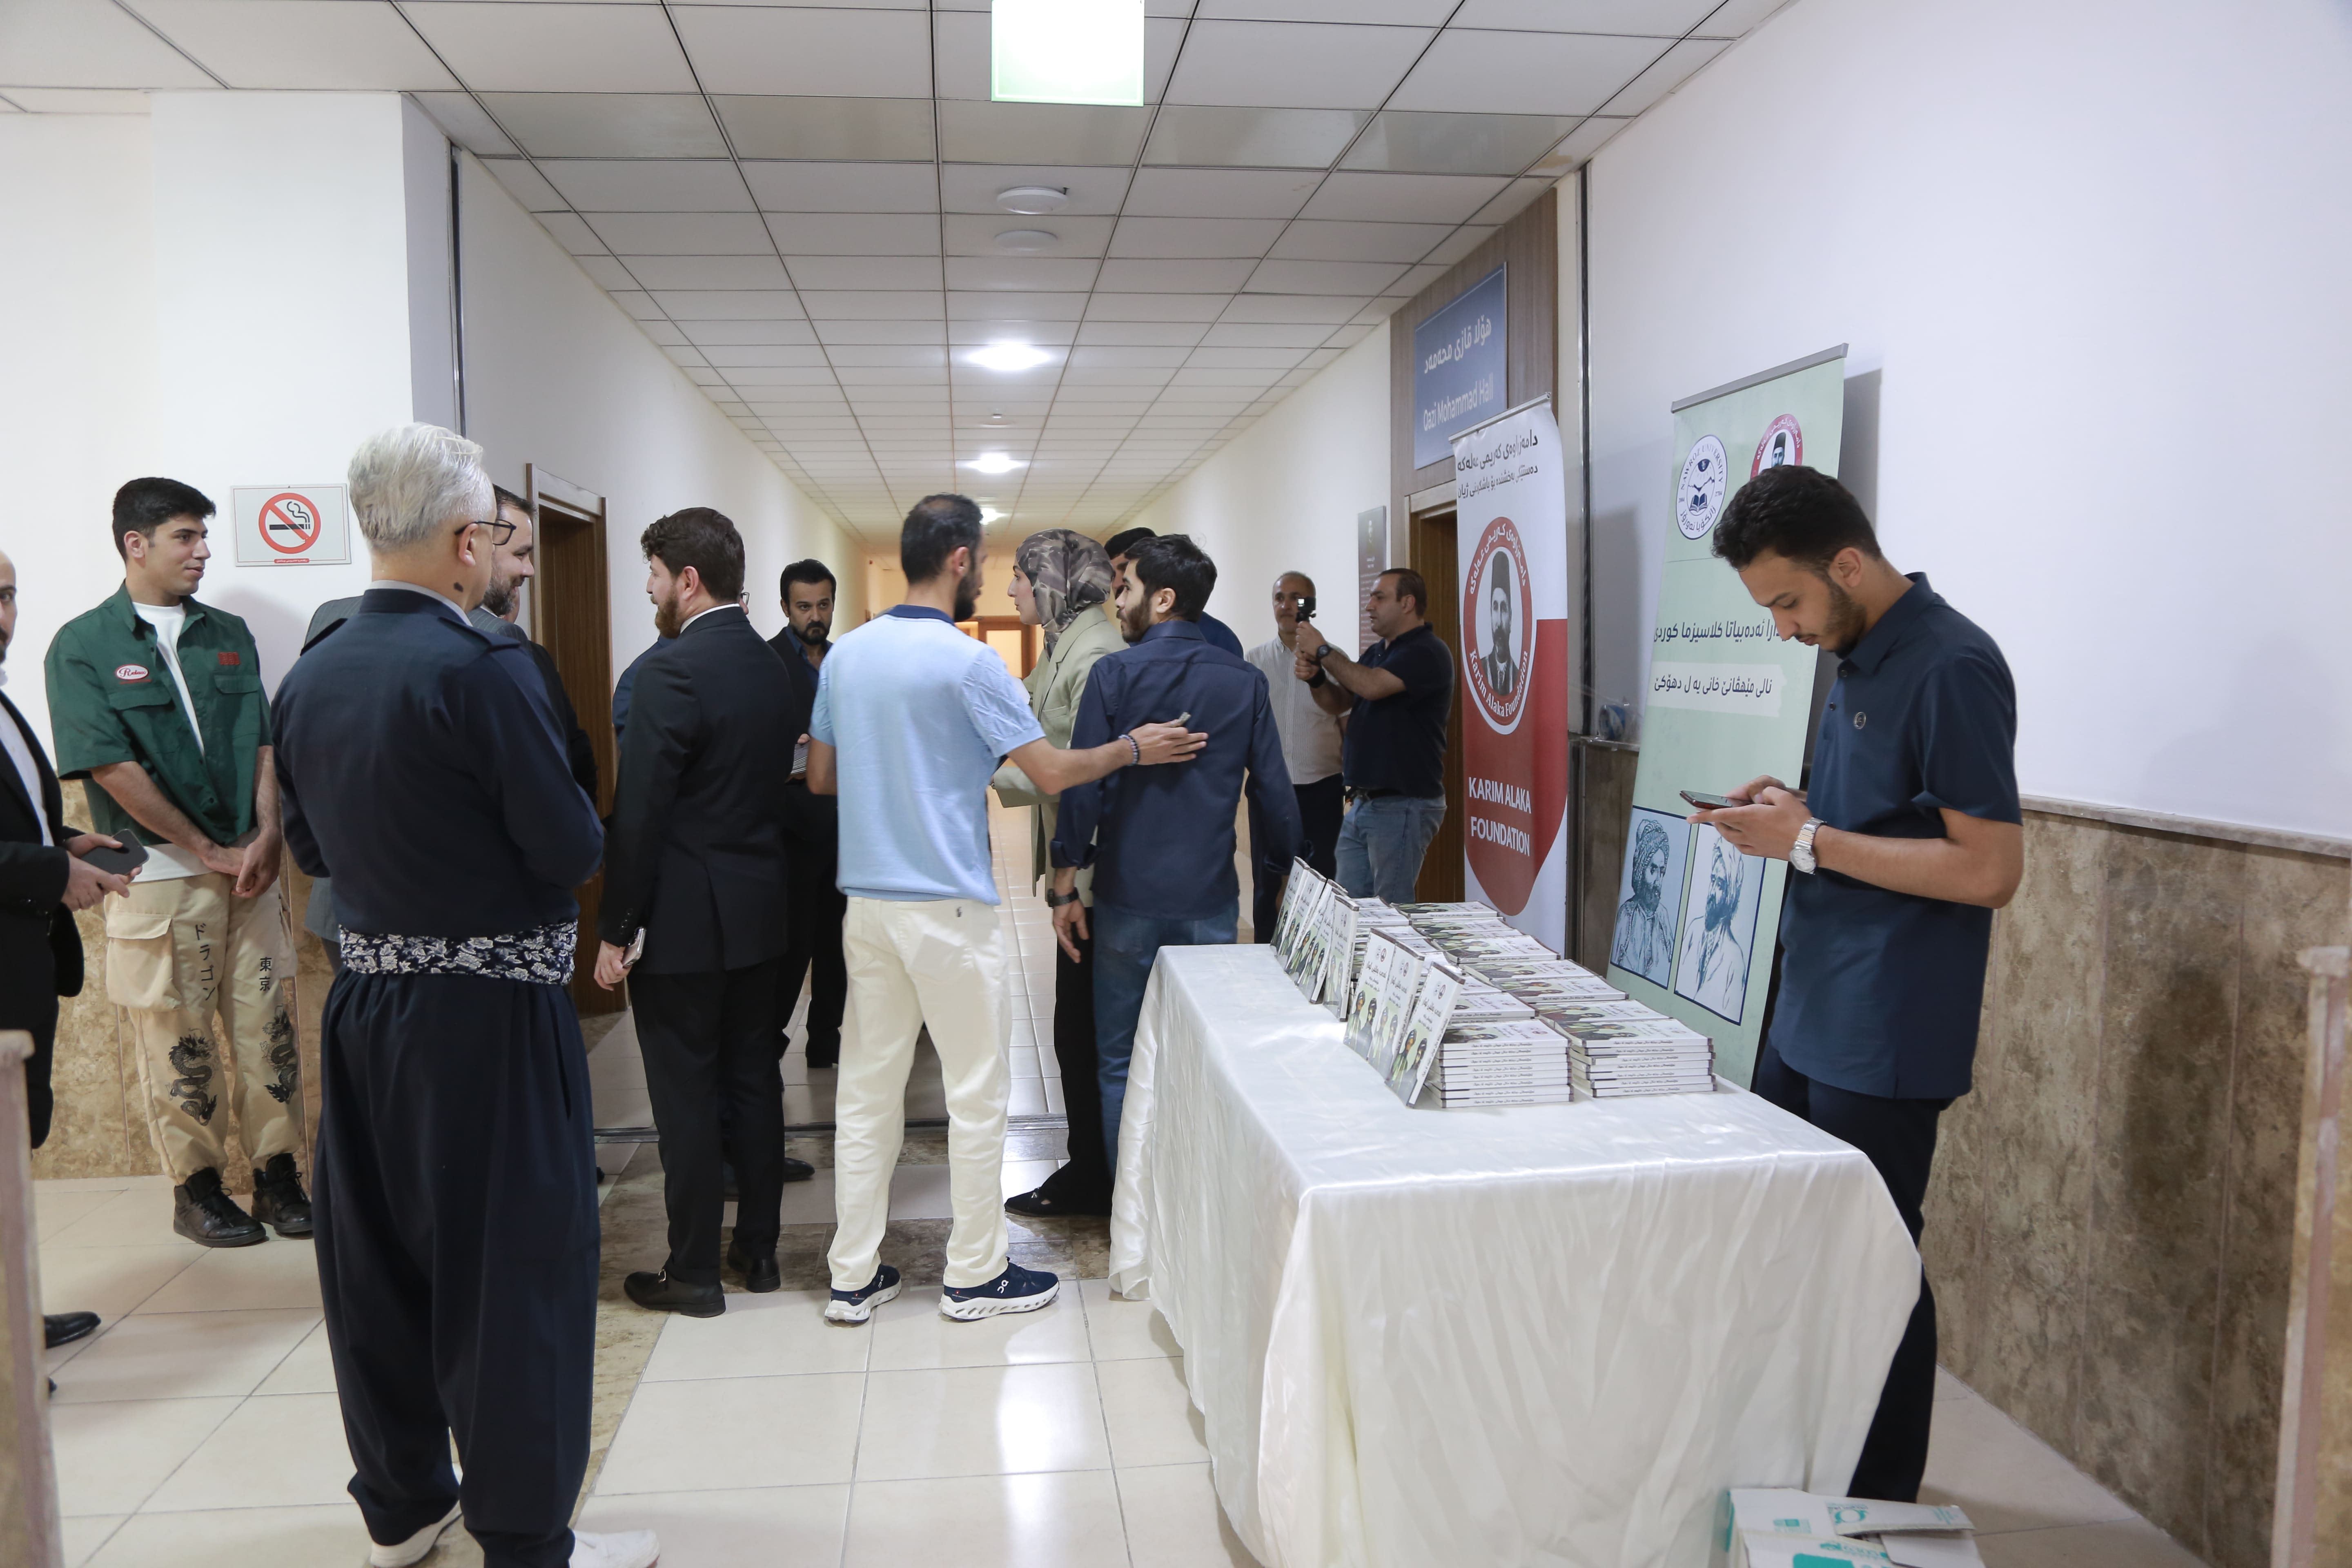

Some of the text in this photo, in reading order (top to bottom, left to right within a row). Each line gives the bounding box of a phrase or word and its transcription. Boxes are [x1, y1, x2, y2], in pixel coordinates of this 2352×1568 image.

[1474, 314, 1491, 346] هۆلا
[1424, 372, 1493, 431] Qazi Mohammad Hall
[1681, 443, 1723, 490] NAWROZ UNIVERSITY
[1470, 648, 1528, 717] Karim Alaka Foundation
[1468, 776, 1531, 814] KARIM ALAKA
[1470, 816, 1530, 857] FOUNDATION
[196, 923, 216, 1000] ドラゴン
[259, 957, 272, 991] 東京
